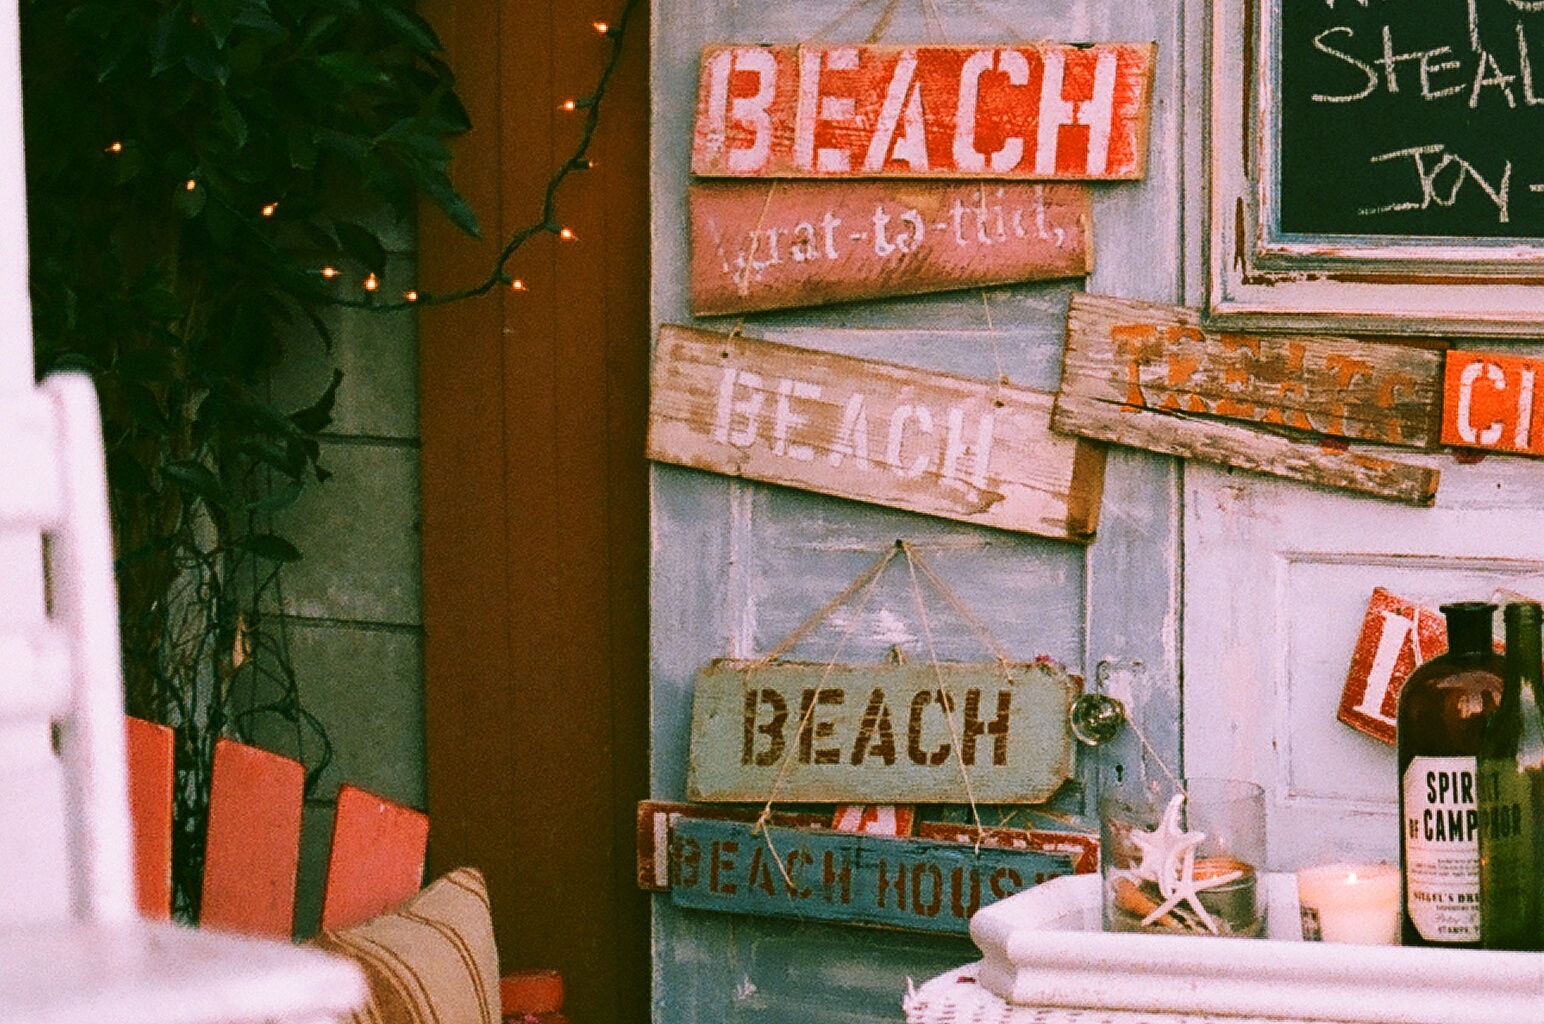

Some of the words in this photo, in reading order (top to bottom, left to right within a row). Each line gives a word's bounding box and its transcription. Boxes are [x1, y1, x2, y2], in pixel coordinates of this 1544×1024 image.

[705, 46, 1119, 175] BEACH
[712, 365, 996, 502] BEACH
[740, 686, 1013, 767] BEACH
[671, 836, 853, 906] BEACH
[875, 857, 1064, 920] HOUS
